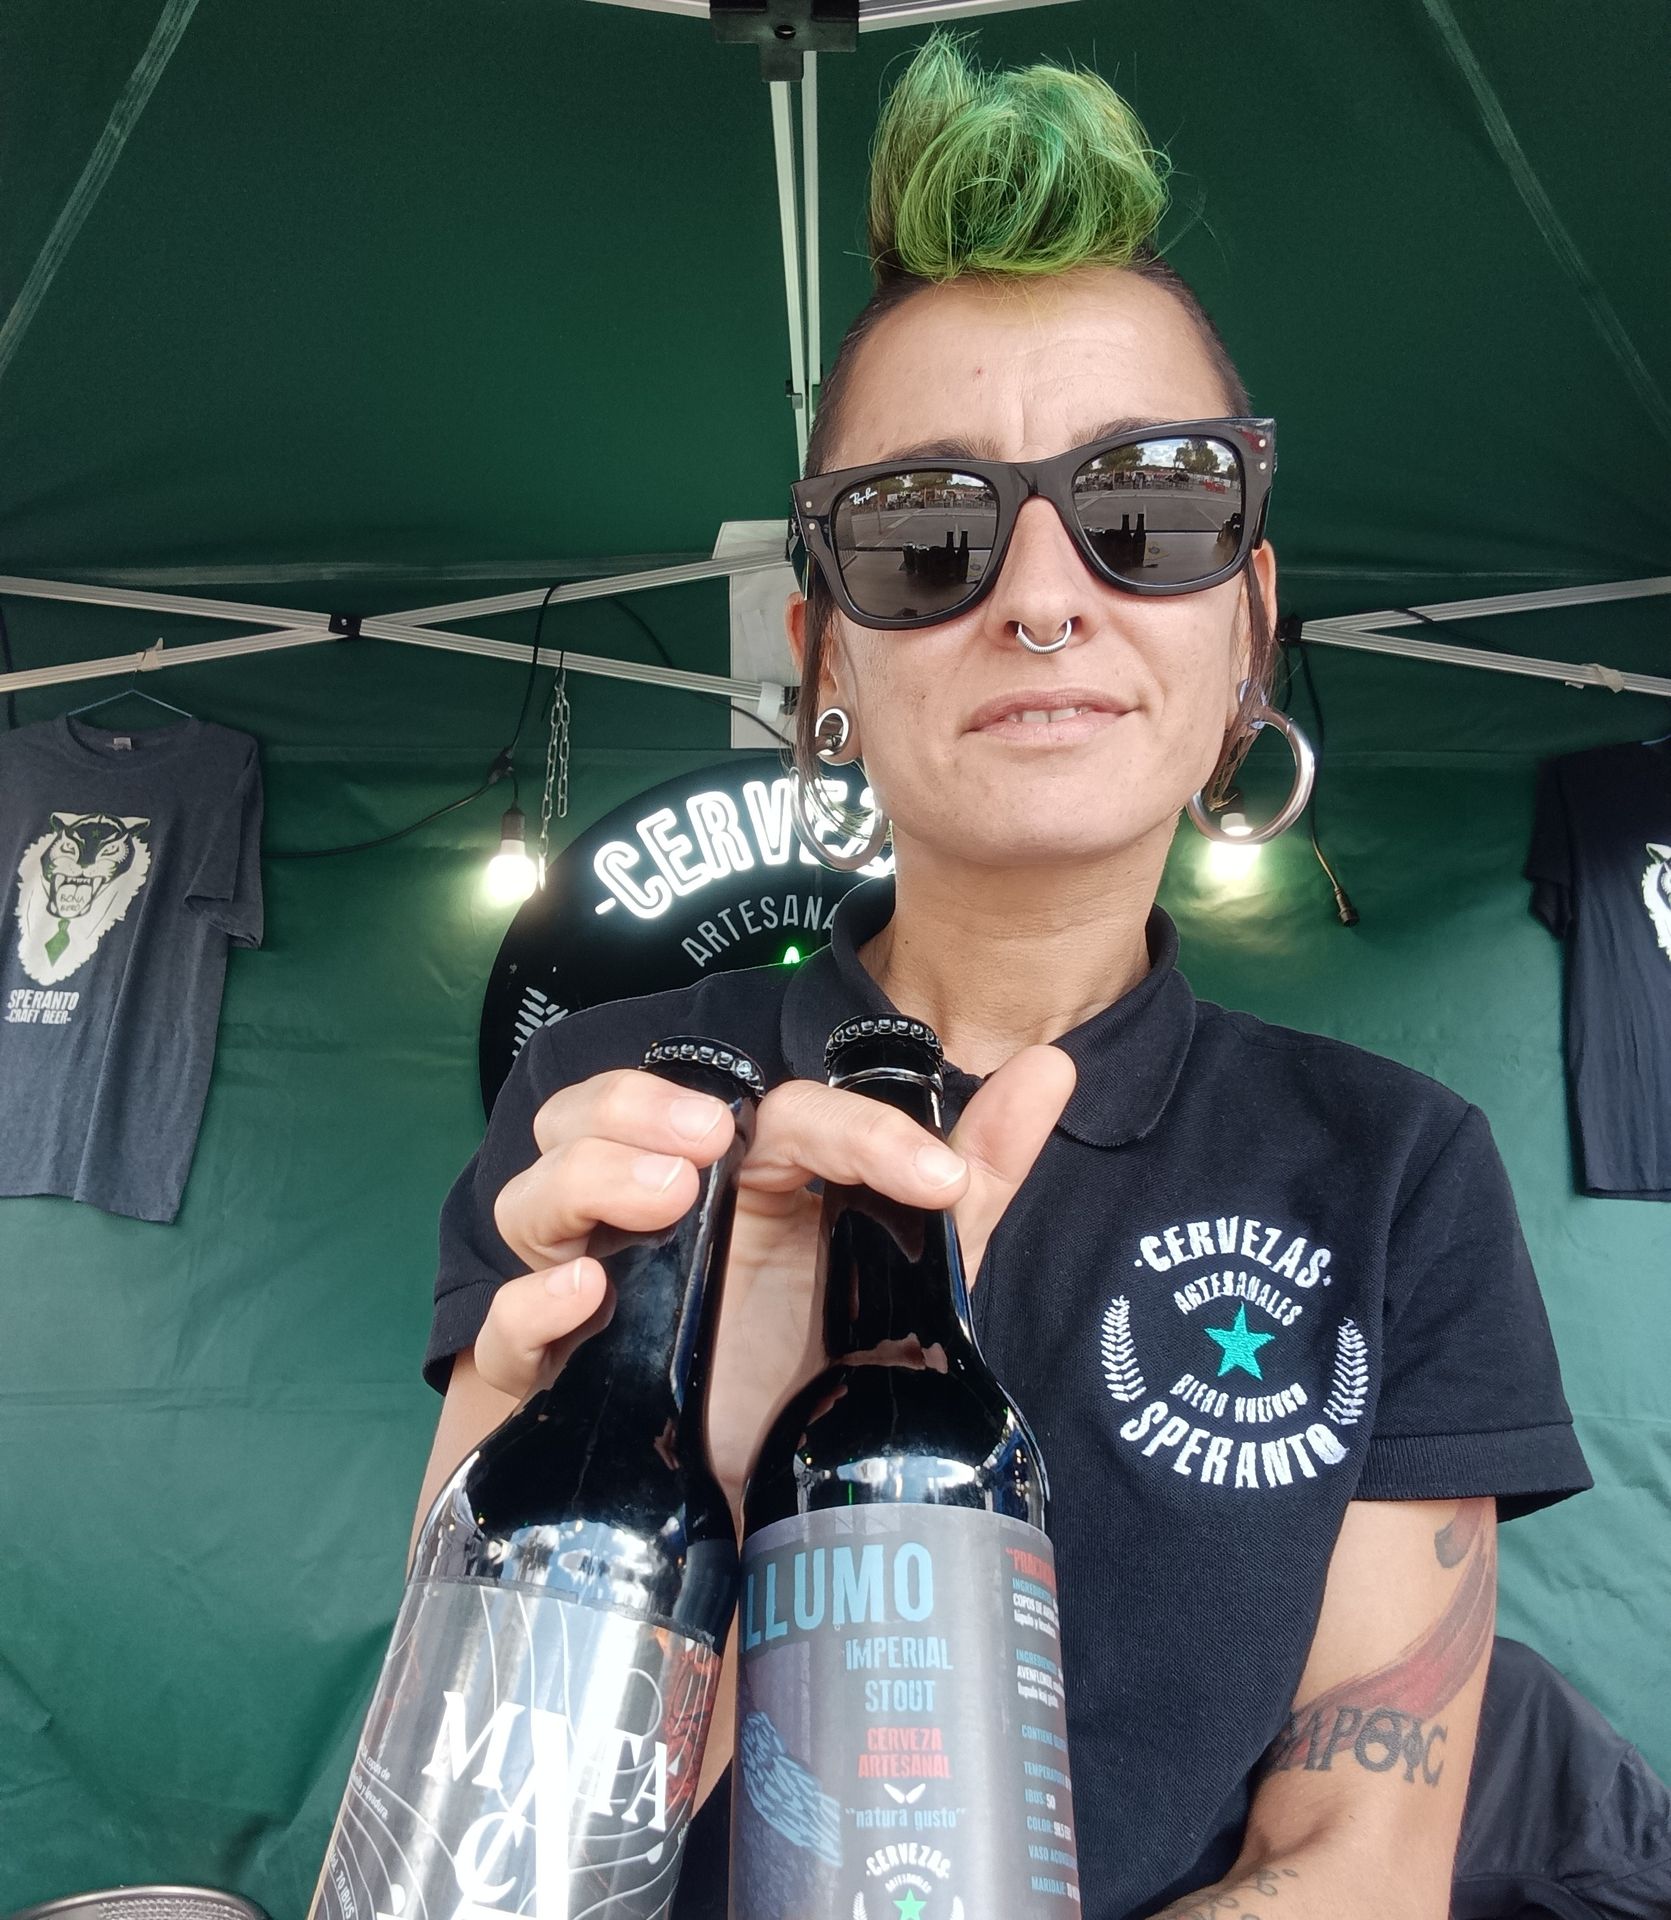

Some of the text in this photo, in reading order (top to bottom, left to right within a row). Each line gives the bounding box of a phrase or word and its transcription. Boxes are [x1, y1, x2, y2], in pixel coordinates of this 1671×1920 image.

[8, 989, 80, 1010] SPERANTO
[1173, 1270, 1303, 1327] ARTESANALES
[1169, 1373, 1229, 1418] BIERO
[1119, 1401, 1350, 1489] SPERANTO
[845, 1636, 954, 1671] IMPERIAL
[864, 1680, 936, 1712] STOUT
[867, 1727, 943, 1751] CERVEZA
[857, 1754, 952, 1779] ARTESANAL
[1046, 1793, 1057, 1811] 50
